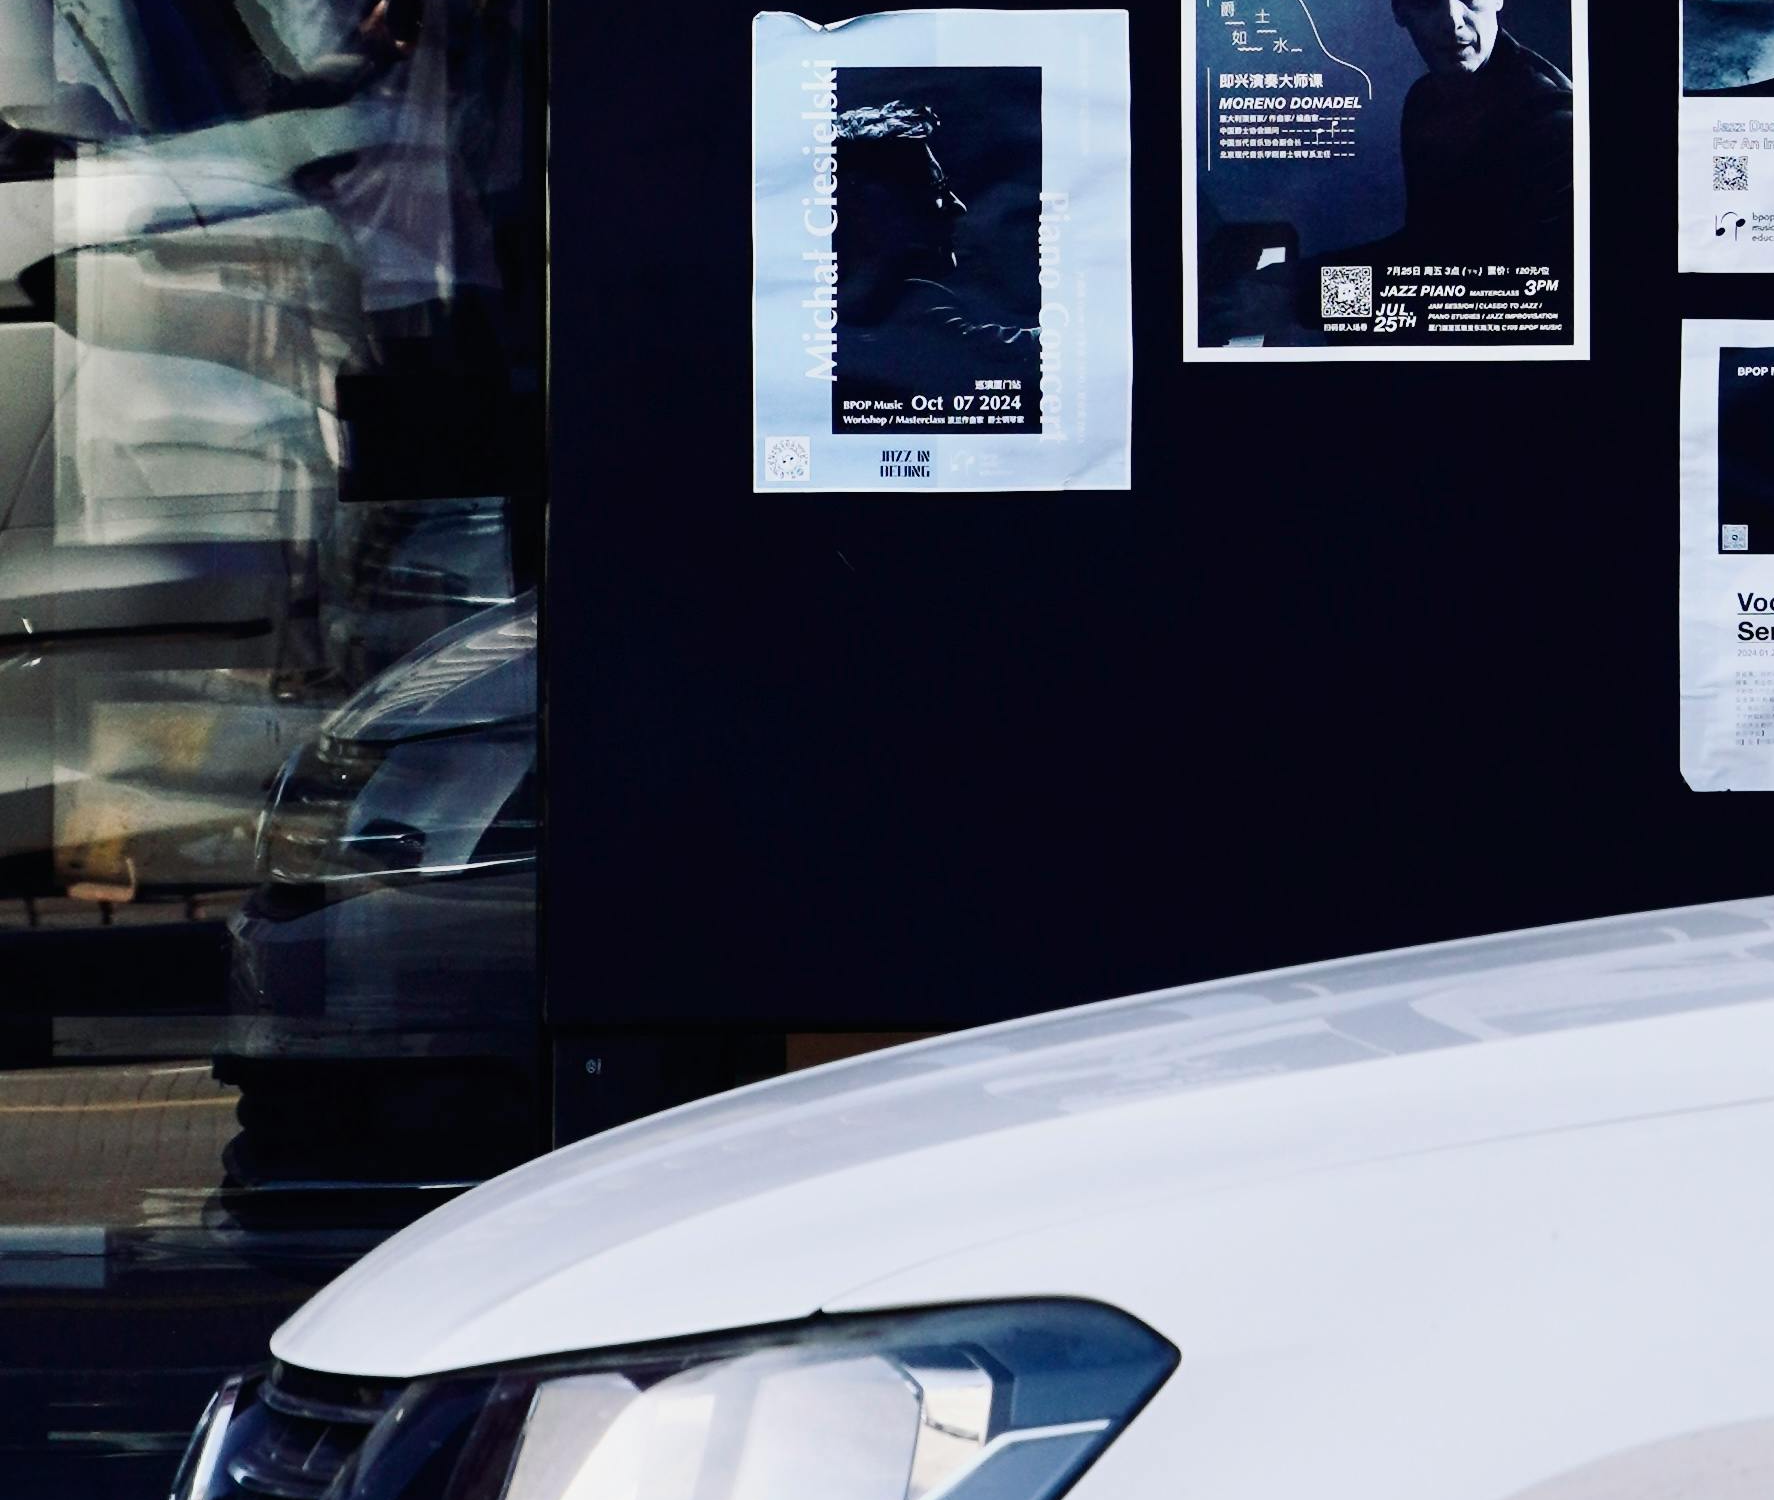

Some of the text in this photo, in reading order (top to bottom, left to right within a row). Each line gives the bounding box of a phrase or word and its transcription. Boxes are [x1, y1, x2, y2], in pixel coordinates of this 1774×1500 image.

[1219, 74, 1323, 89] 即兴演奏大师课
[1219, 96, 1363, 109] MORENO DONADEL
[800, 58, 837, 238] Ciesielski
[1740, 137, 1760, 149] An
[1380, 285, 1417, 297] JAZZ
[1420, 285, 1466, 297] PIANO
[1524, 280, 1560, 296] 3PM
[1375, 304, 1414, 317] JUL.
[1373, 317, 1417, 332] 25TH
[1737, 366, 1769, 377] BPOP
[843, 395, 1022, 411] BPOP Music Oct 07 2024
[843, 414, 946, 426] Workshop Masterclass
